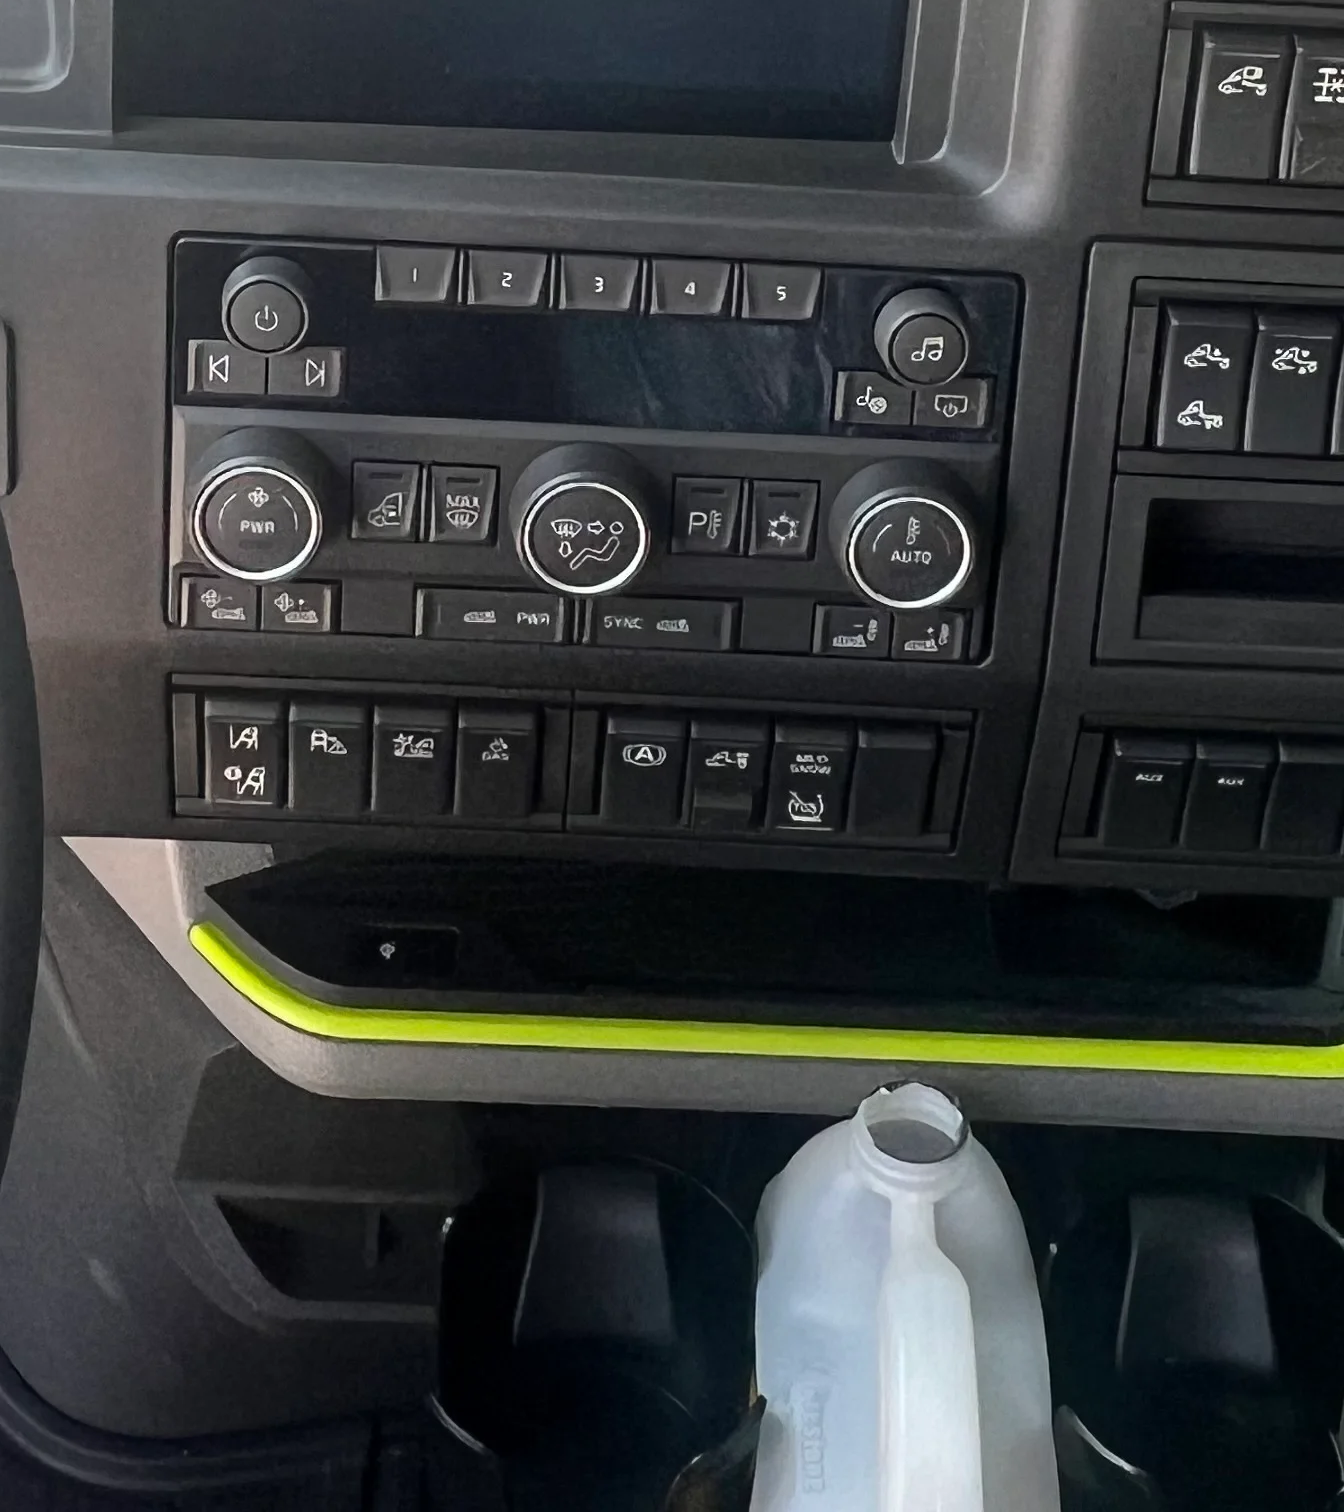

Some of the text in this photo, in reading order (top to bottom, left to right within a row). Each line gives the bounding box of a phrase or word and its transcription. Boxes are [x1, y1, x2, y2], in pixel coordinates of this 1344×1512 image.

[501, 272, 513, 288] 2
[594, 276, 605, 293] 3
[684, 281, 696, 296] 4
[776, 286, 787, 301] 5
[240, 519, 275, 534] PWR
[890, 550, 932, 565] AUTO
[516, 611, 550, 626] PWR
[603, 616, 644, 630] SYNC
